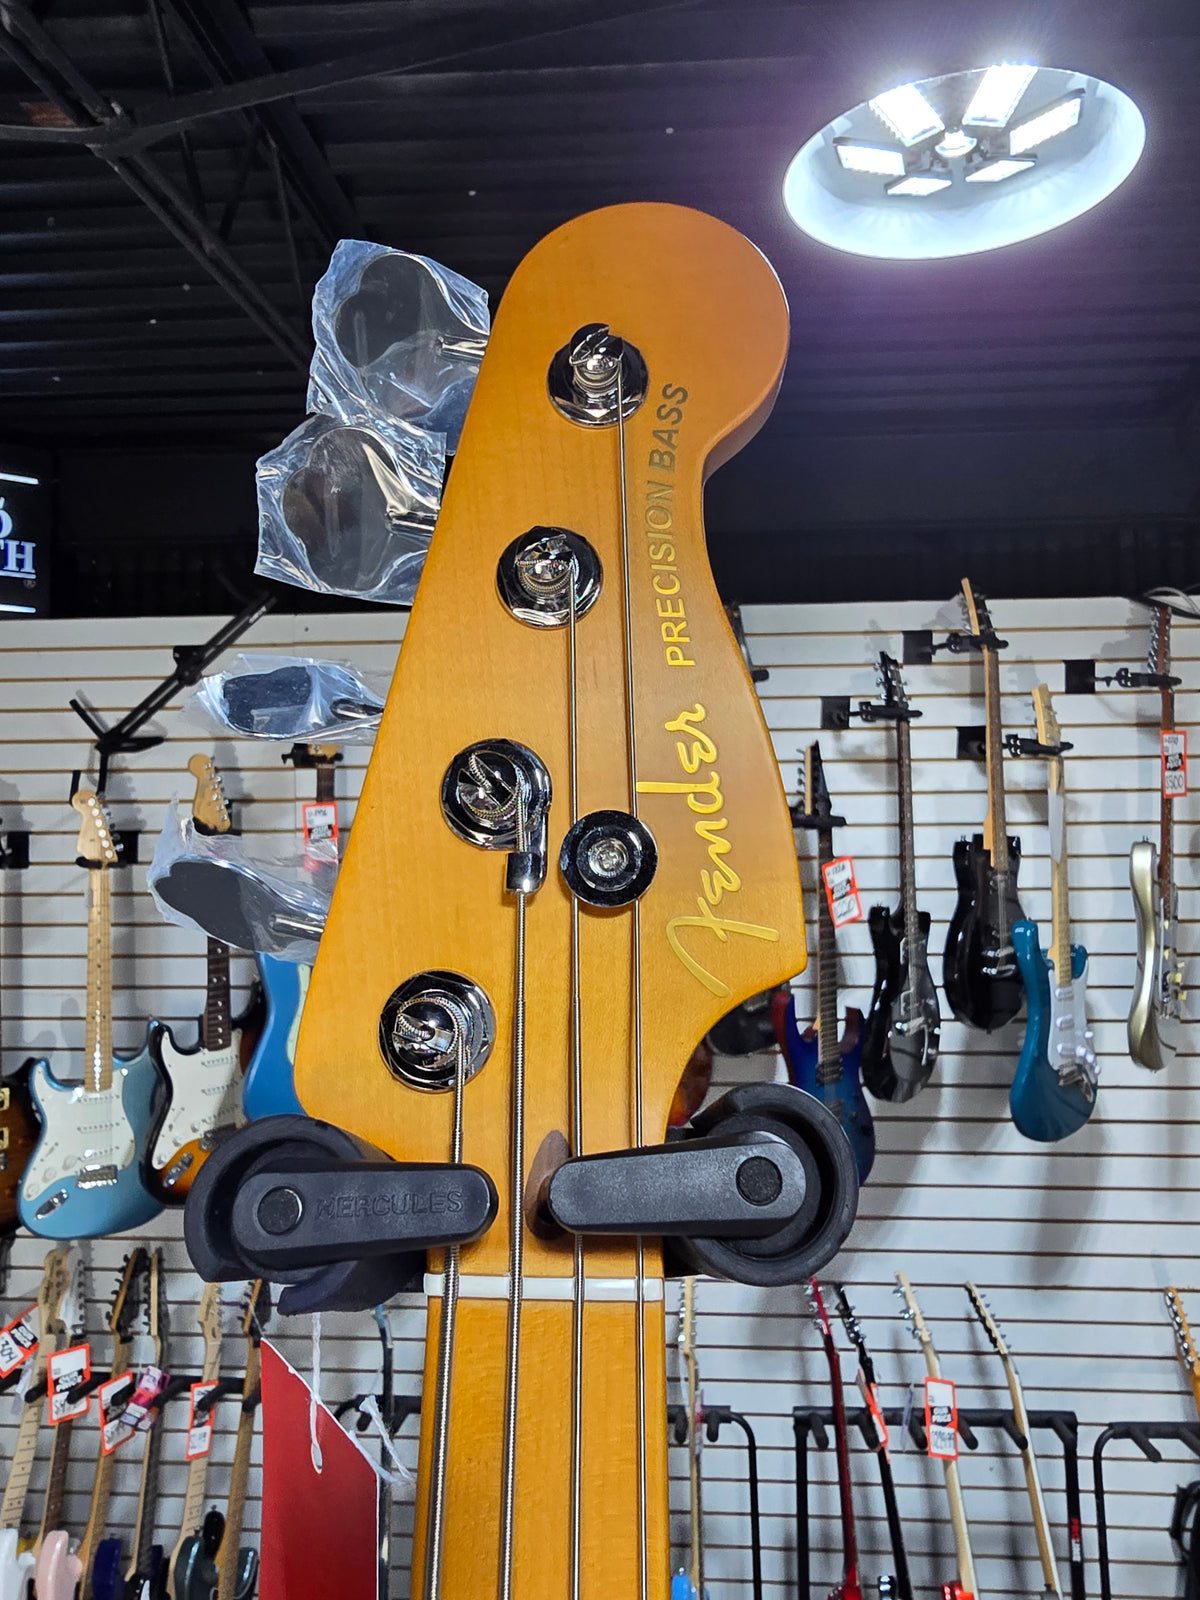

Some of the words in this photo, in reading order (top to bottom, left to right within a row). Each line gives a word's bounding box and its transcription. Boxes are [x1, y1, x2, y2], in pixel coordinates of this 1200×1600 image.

[648, 382, 689, 472] BASS
[645, 481, 696, 667] PRECISION
[636, 703, 780, 998] Fender
[316, 1190, 463, 1219] HERCULES
